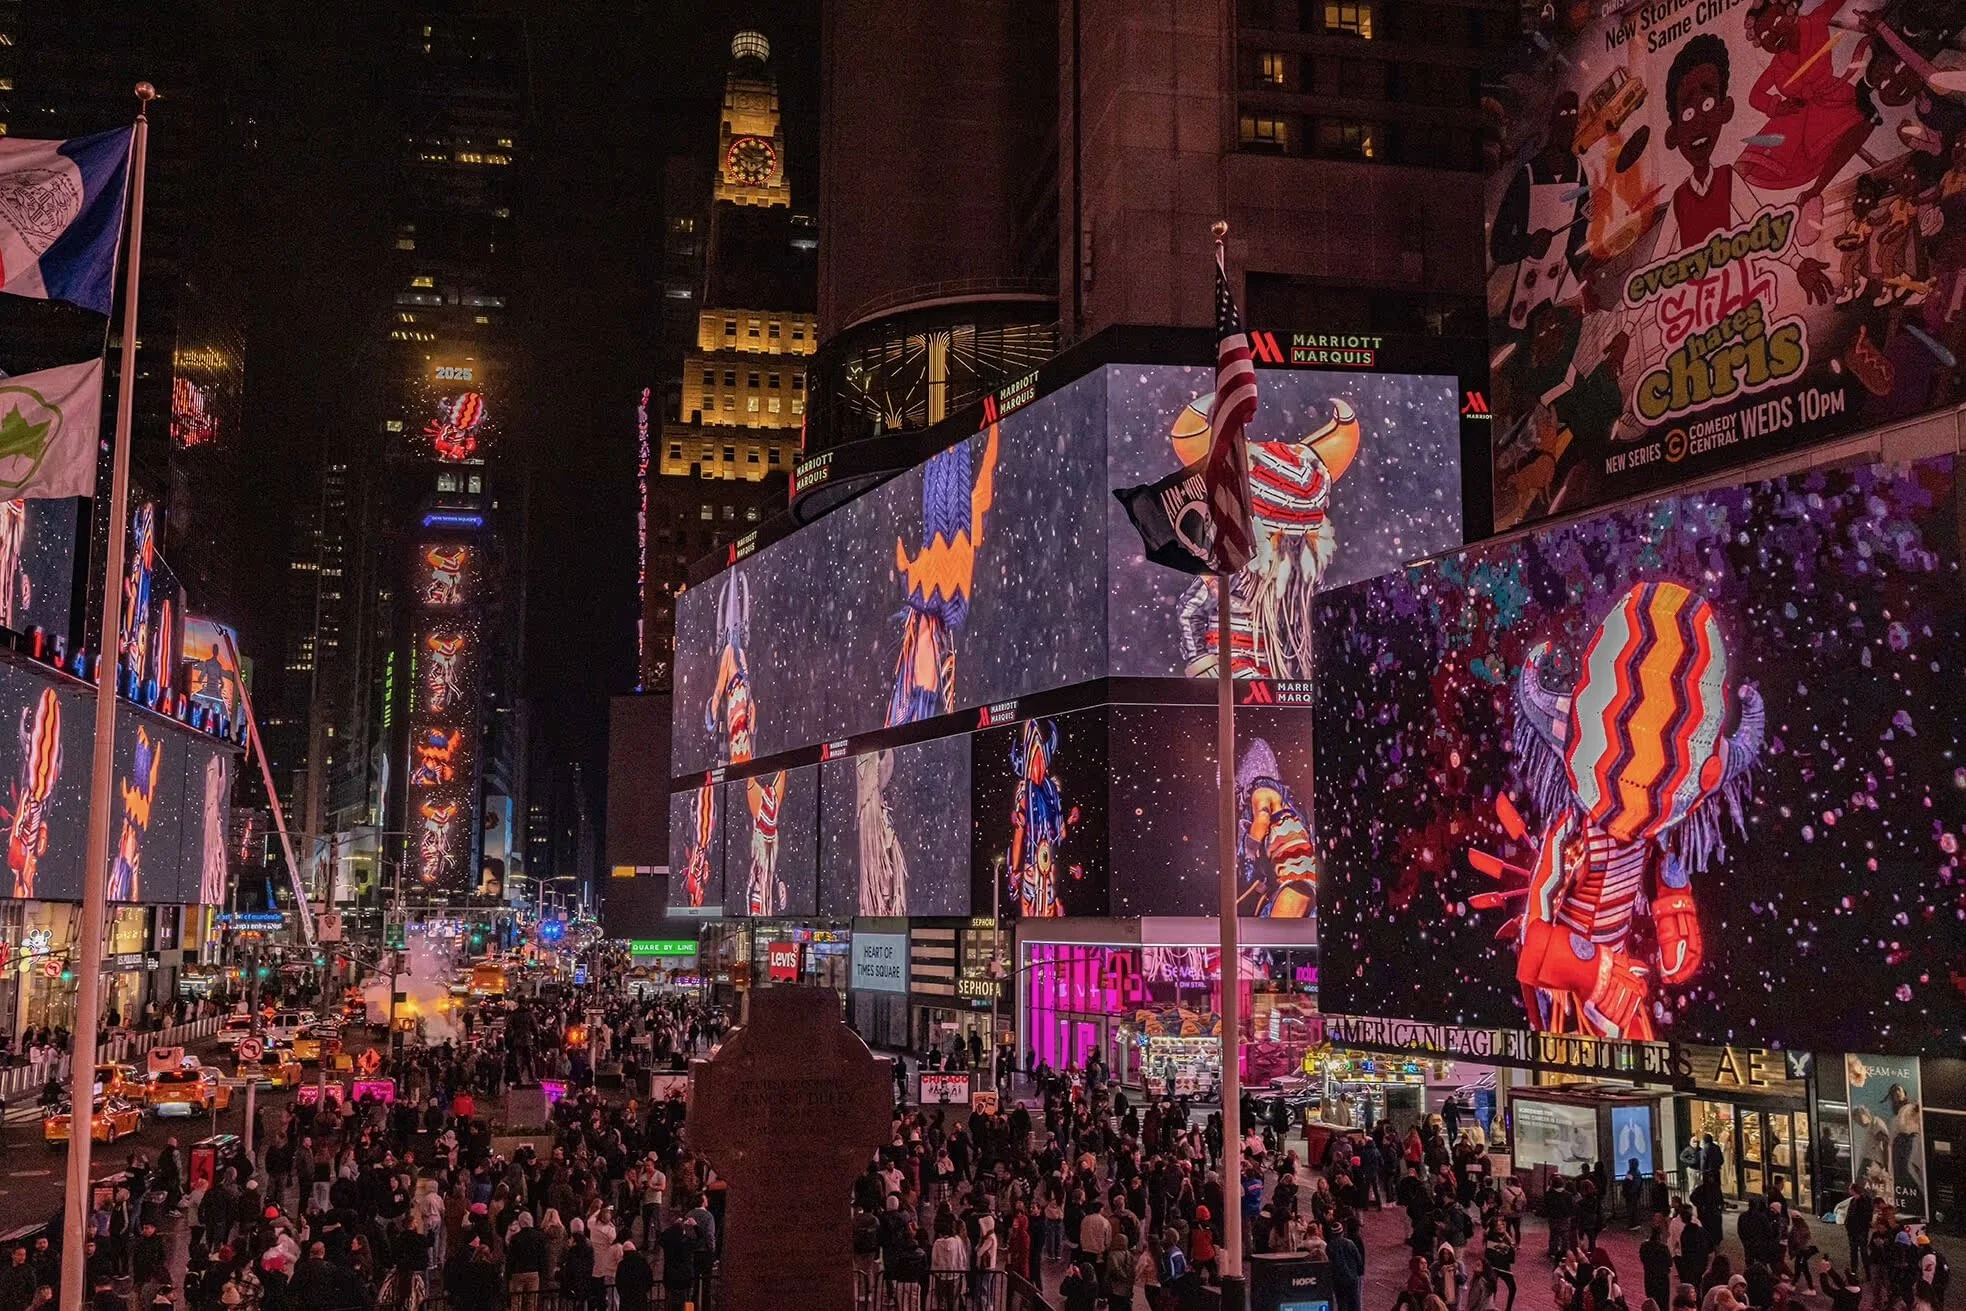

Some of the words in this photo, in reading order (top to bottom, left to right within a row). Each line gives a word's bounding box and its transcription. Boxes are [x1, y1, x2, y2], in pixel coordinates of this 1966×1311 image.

[1605, 20, 1637, 52] New
[1648, 16, 1693, 54] Same
[1627, 210, 1795, 303] everybody
[1293, 334, 1383, 349] MARRIOTT
[1684, 298, 1764, 362] hates
[1293, 351, 1373, 364] MARQUIS
[1637, 322, 1805, 419] chris
[435, 366, 473, 381] 2025
[1000, 370, 1040, 401] MARRIOTT
[1000, 387, 1035, 415] MARQUIS
[1740, 396, 1794, 440] WEDS
[1797, 387, 1846, 424] 10PM
[1689, 412, 1737, 441] COMEDY
[1690, 428, 1739, 456] CENTRAL
[796, 452, 834, 478] MARRIOTT
[1605, 456, 1626, 475] NEW
[1628, 442, 1662, 469] SERIES
[796, 468, 828, 491] MARQUIS
[1278, 693, 1312, 703] MARQ
[863, 946, 883, 958] HEART
[883, 947, 893, 959] OF
[857, 963, 874, 977] TIMES
[875, 965, 900, 979] SQUARE
[1332, 1014, 1439, 1052] AMERICAN
[1443, 1026, 1517, 1060] EAGLE
[1714, 1044, 1769, 1088] AE
[1862, 1064, 1891, 1078] REAM
